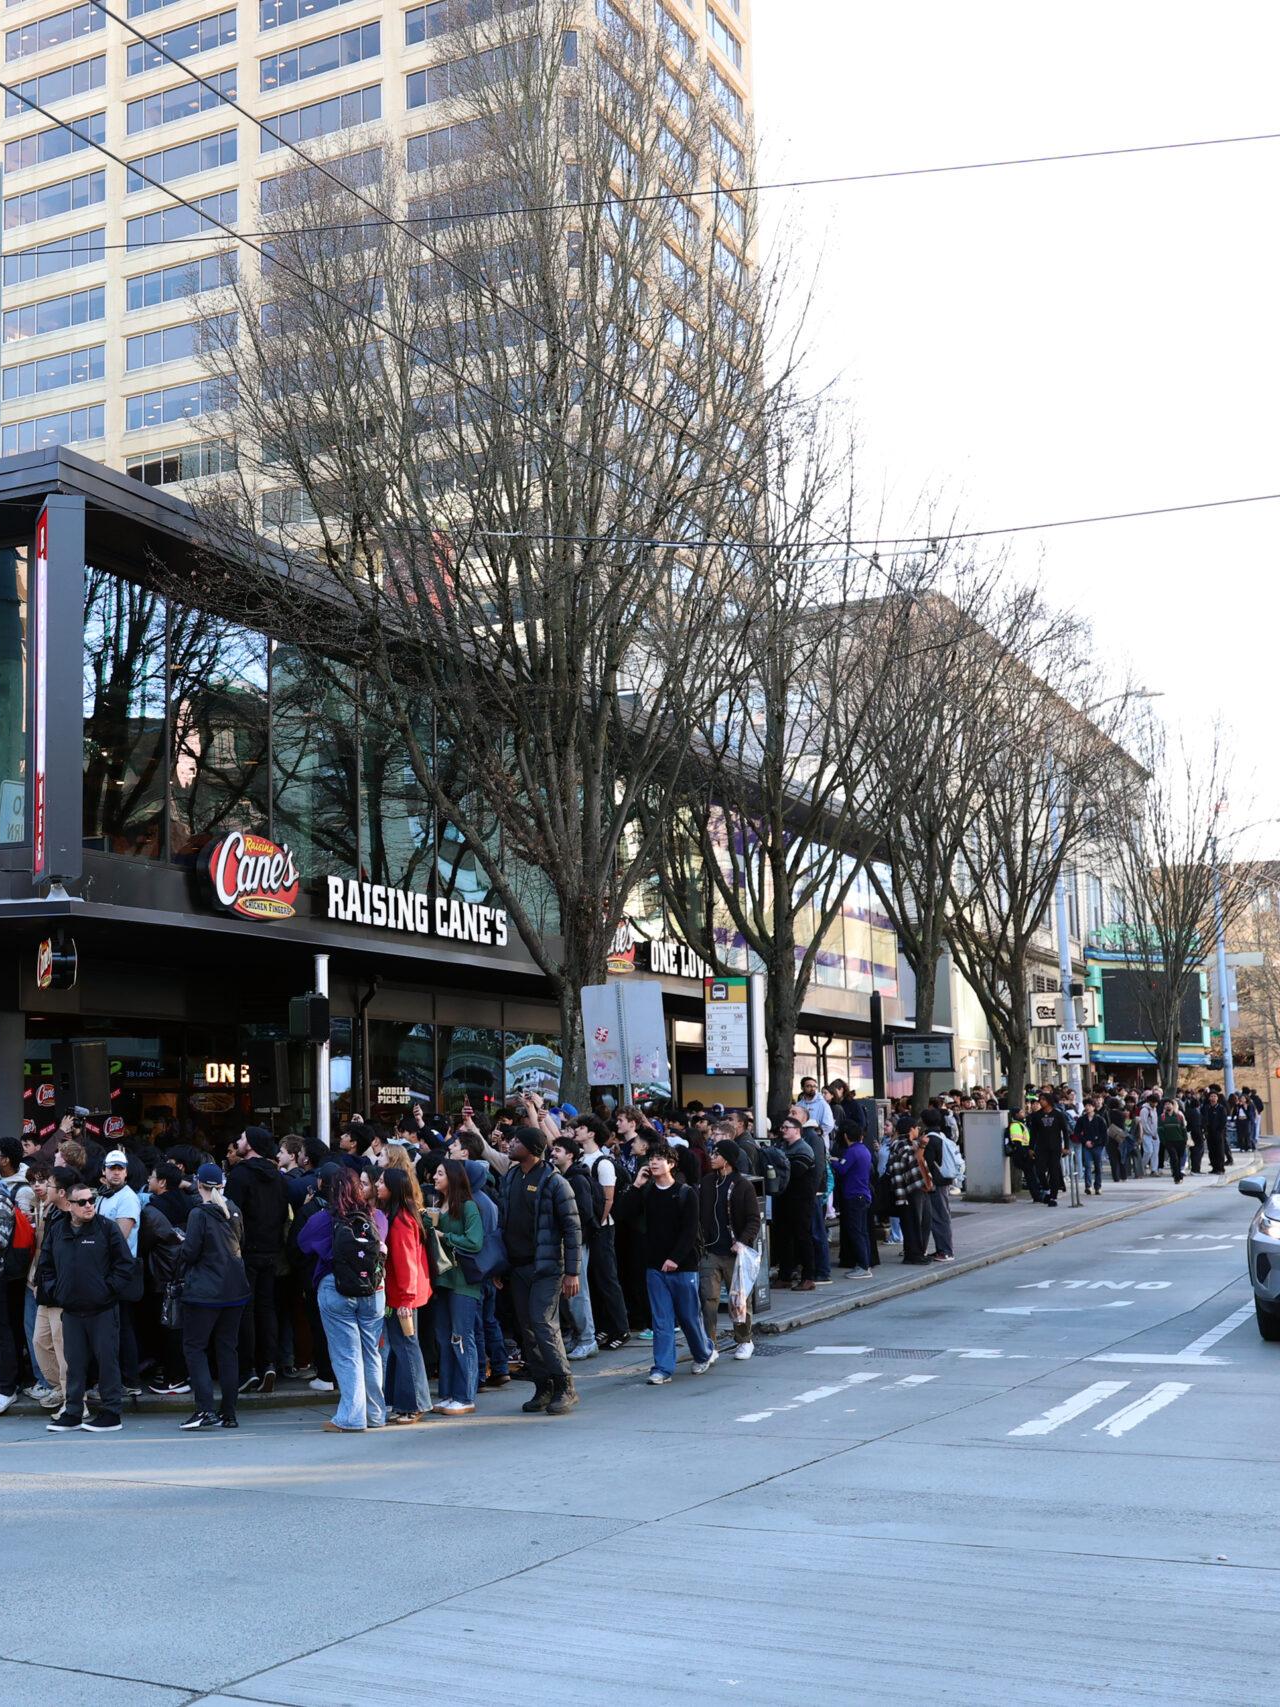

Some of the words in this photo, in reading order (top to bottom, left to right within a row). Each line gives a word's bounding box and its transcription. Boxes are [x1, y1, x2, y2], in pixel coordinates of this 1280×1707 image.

[245, 837, 274, 857] Raising
[216, 831, 300, 906] Cane's
[327, 875, 429, 934] RAISING
[435, 897, 508, 947] CANE'S
[650, 940, 678, 975] ONE
[1060, 1033, 1080, 1041] ONE
[1060, 1042, 1081, 1050] WAY
[377, 1086, 410, 1096] MOBILE
[377, 1095, 411, 1104] PICK-UP
[1015, 1280, 1174, 1290] ONLY
